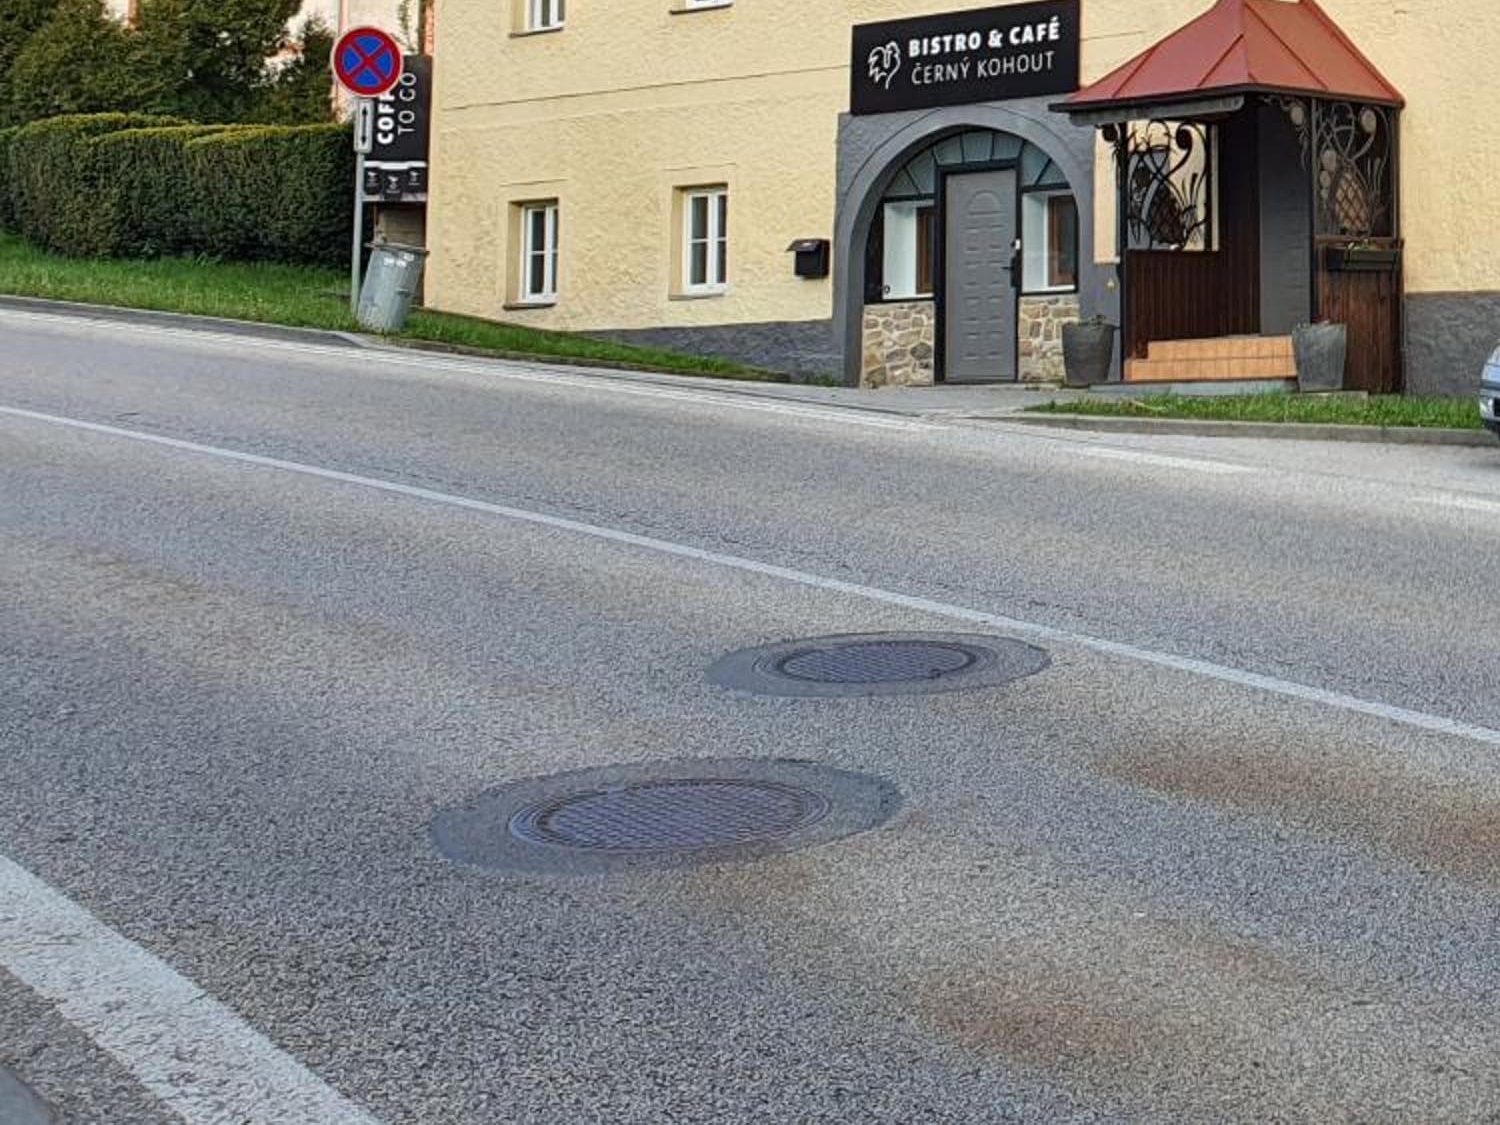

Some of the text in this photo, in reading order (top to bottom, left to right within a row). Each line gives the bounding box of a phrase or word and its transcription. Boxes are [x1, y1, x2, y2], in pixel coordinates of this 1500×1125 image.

[908, 16, 1061, 58] BISTRO & CAFÉ
[911, 51, 1055, 85] ČERNÝ KOHOUT
[377, 90, 395, 144] COFF
[397, 109, 416, 135] TO
